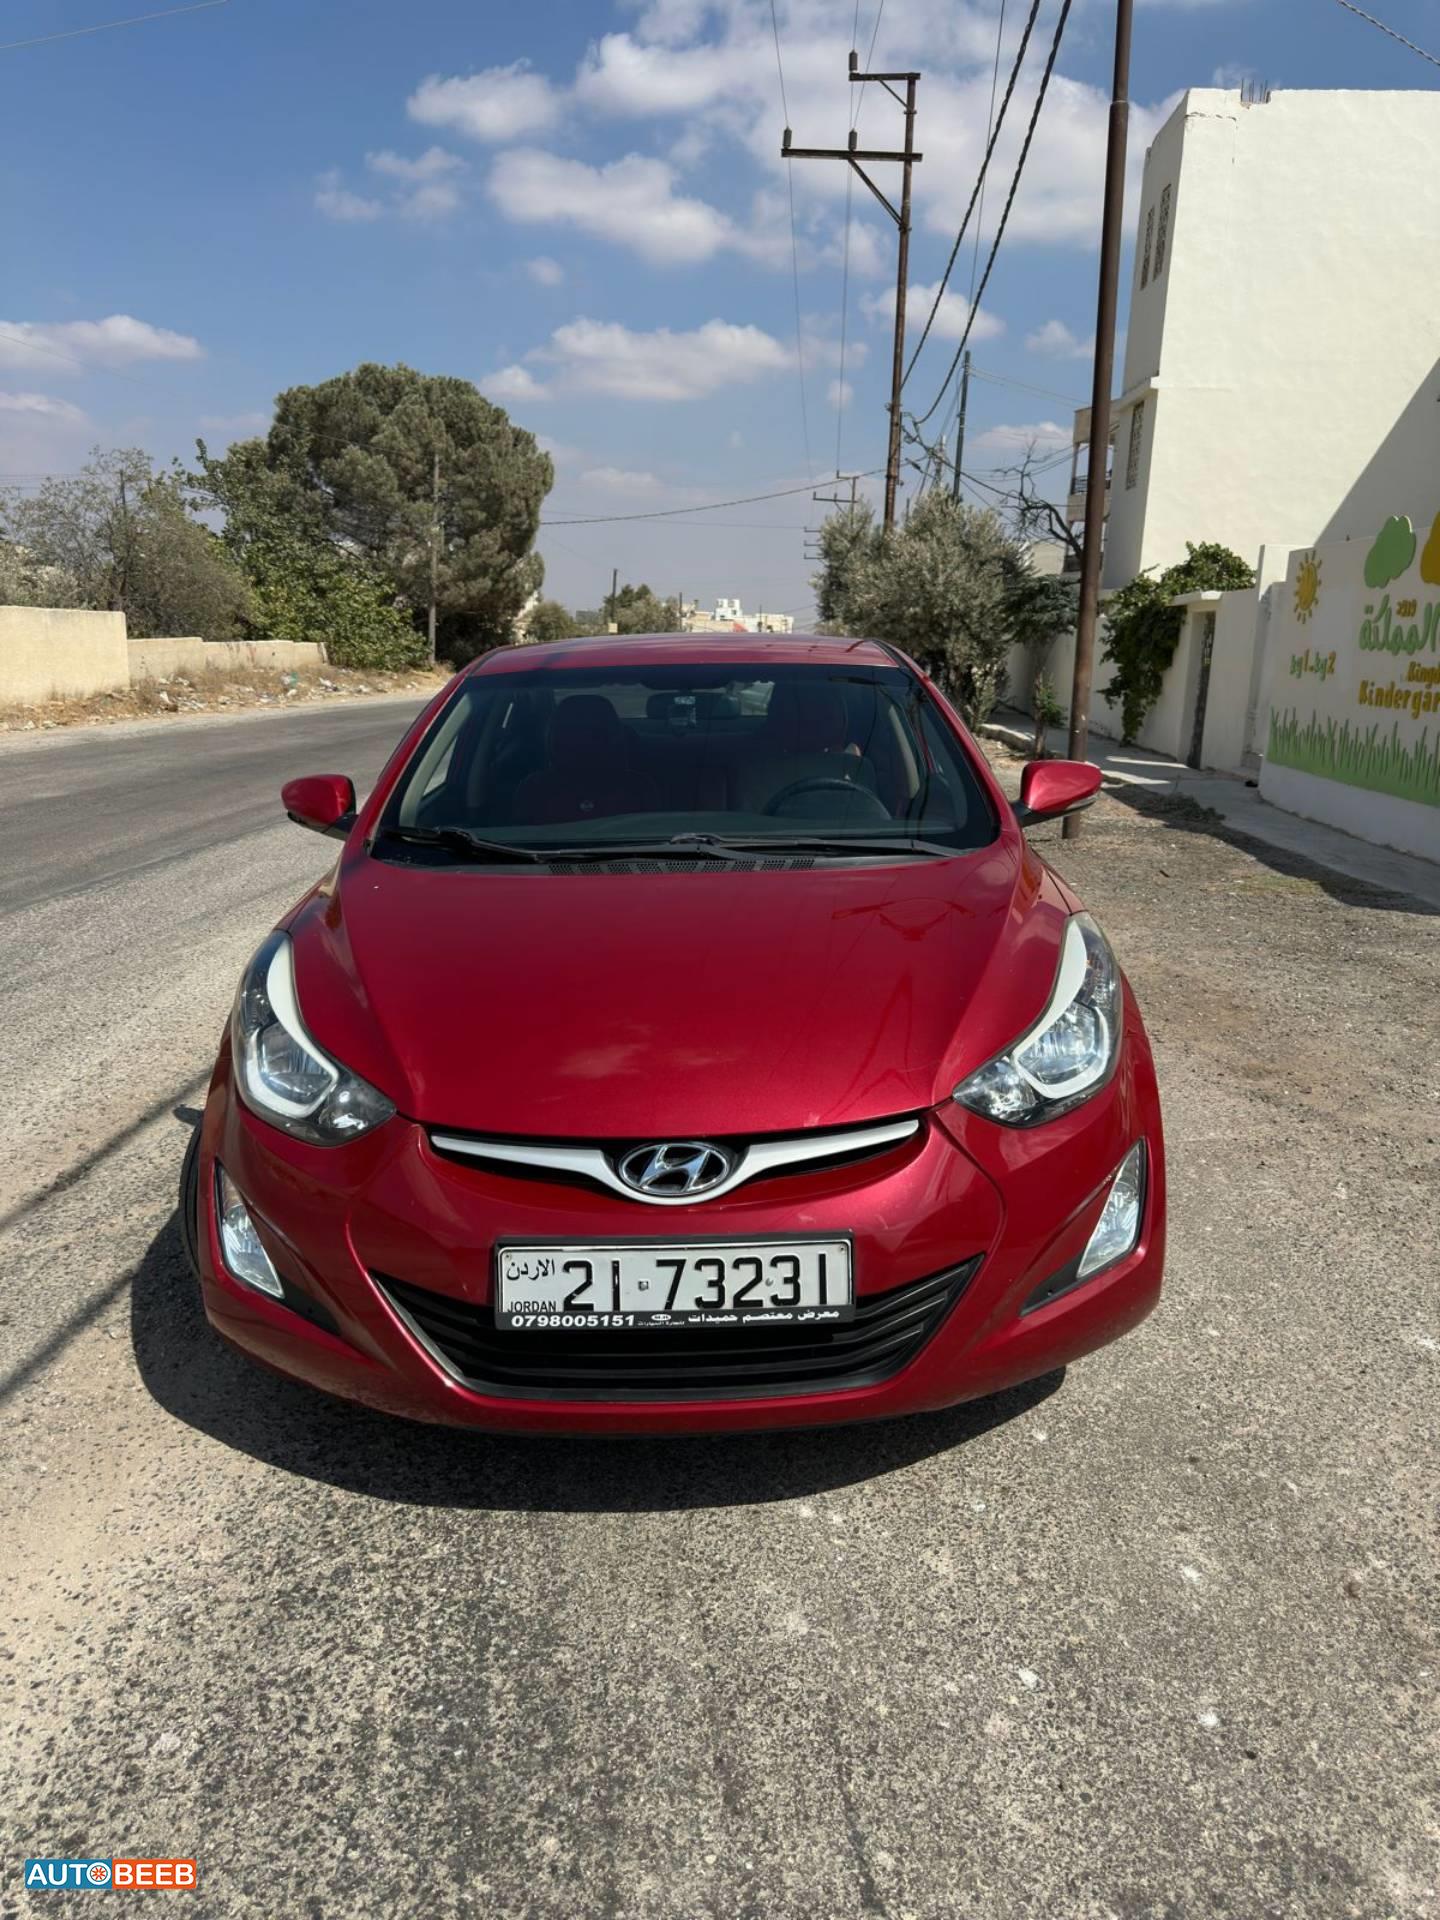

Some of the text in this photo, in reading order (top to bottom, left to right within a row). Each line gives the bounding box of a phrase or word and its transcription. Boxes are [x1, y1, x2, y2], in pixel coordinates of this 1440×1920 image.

[506, 1258, 556, 1281] الاردن
[562, 1253, 827, 1311] 21 73231
[507, 1300, 556, 1313] JORDAN
[511, 1314, 635, 1328] 0798005151
[688, 1309, 840, 1324] معرض معتصم حميدات
